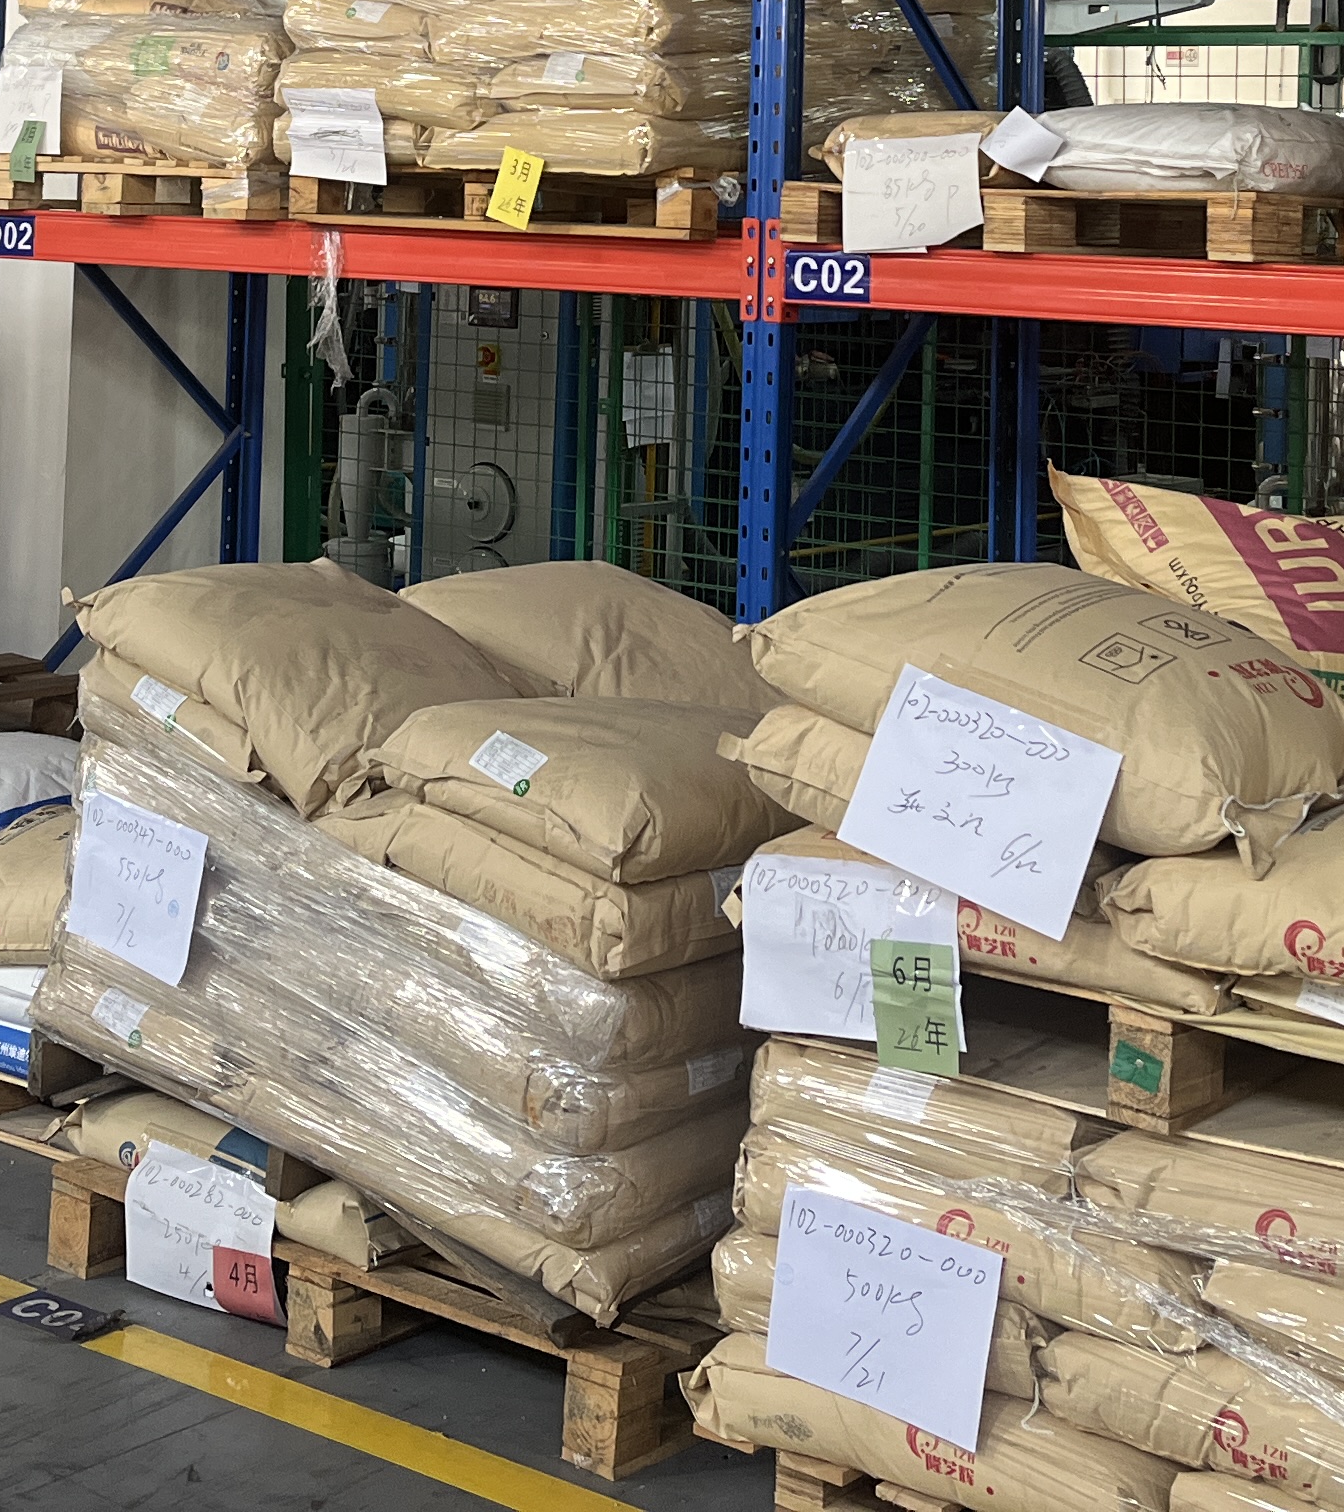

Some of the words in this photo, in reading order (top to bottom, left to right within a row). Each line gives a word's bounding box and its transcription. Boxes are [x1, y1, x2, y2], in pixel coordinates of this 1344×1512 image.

[792, 254, 866, 294] C02
[892, 956, 932, 993] 6月
[787, 1199, 988, 1286] 102-000320-000
[229, 1262, 259, 1295] 4月
[11, 1298, 87, 1331] C0
[839, 1330, 886, 1393] 7/21
